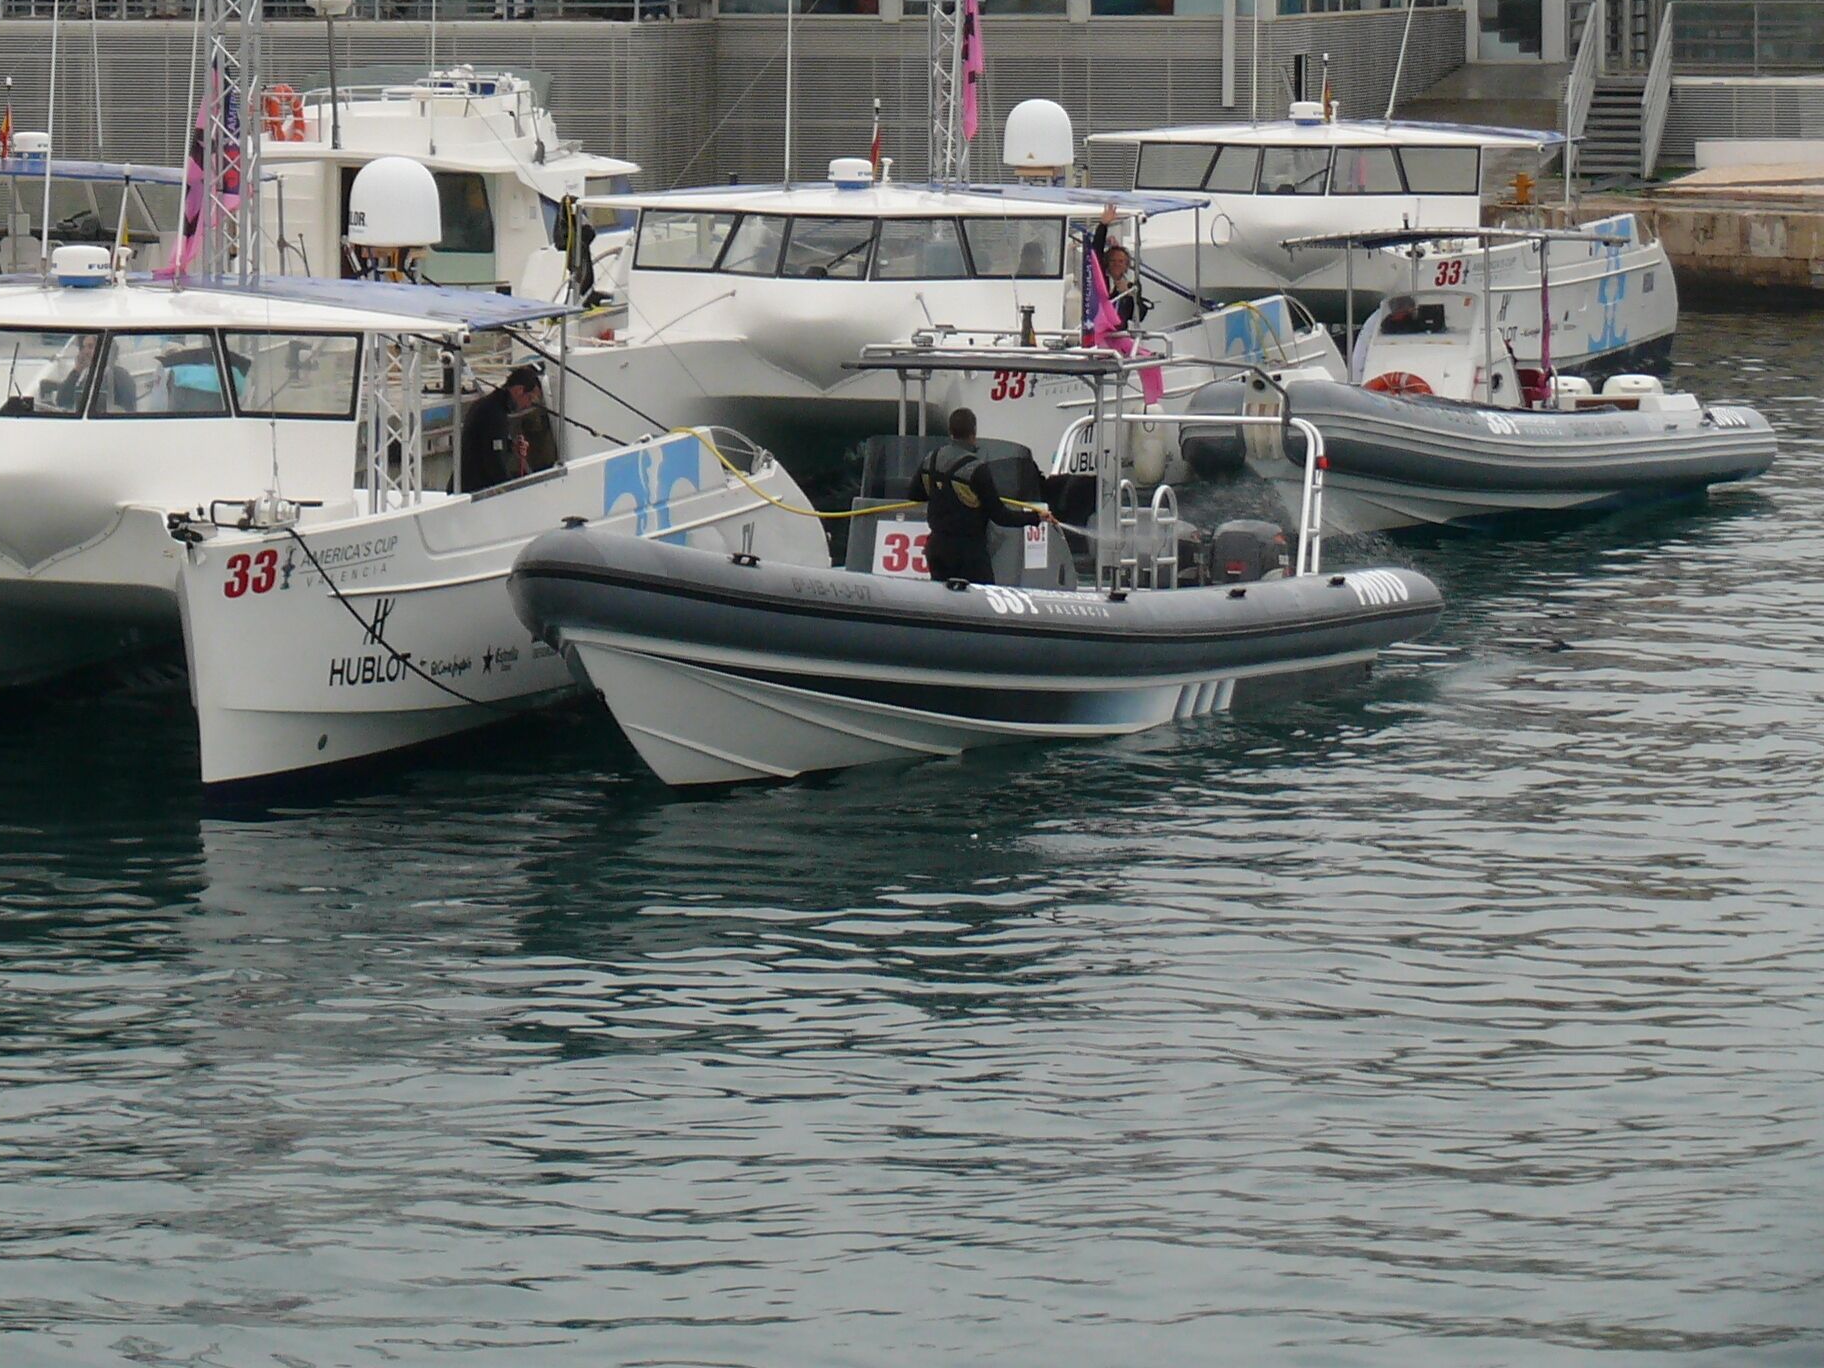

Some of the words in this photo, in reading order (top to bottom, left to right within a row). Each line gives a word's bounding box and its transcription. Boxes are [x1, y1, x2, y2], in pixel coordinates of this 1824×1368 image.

[1434, 260, 1462, 287] 33
[991, 370, 1026, 401] 33
[1069, 448, 1111, 473] UBLT
[224, 549, 279, 599] 33
[300, 541, 372, 568] AMERICA'S
[374, 535, 399, 556] CUP
[882, 533, 930, 574] 33
[1044, 603, 1111, 619] VALENCIA
[329, 653, 411, 686] HUBLOT
